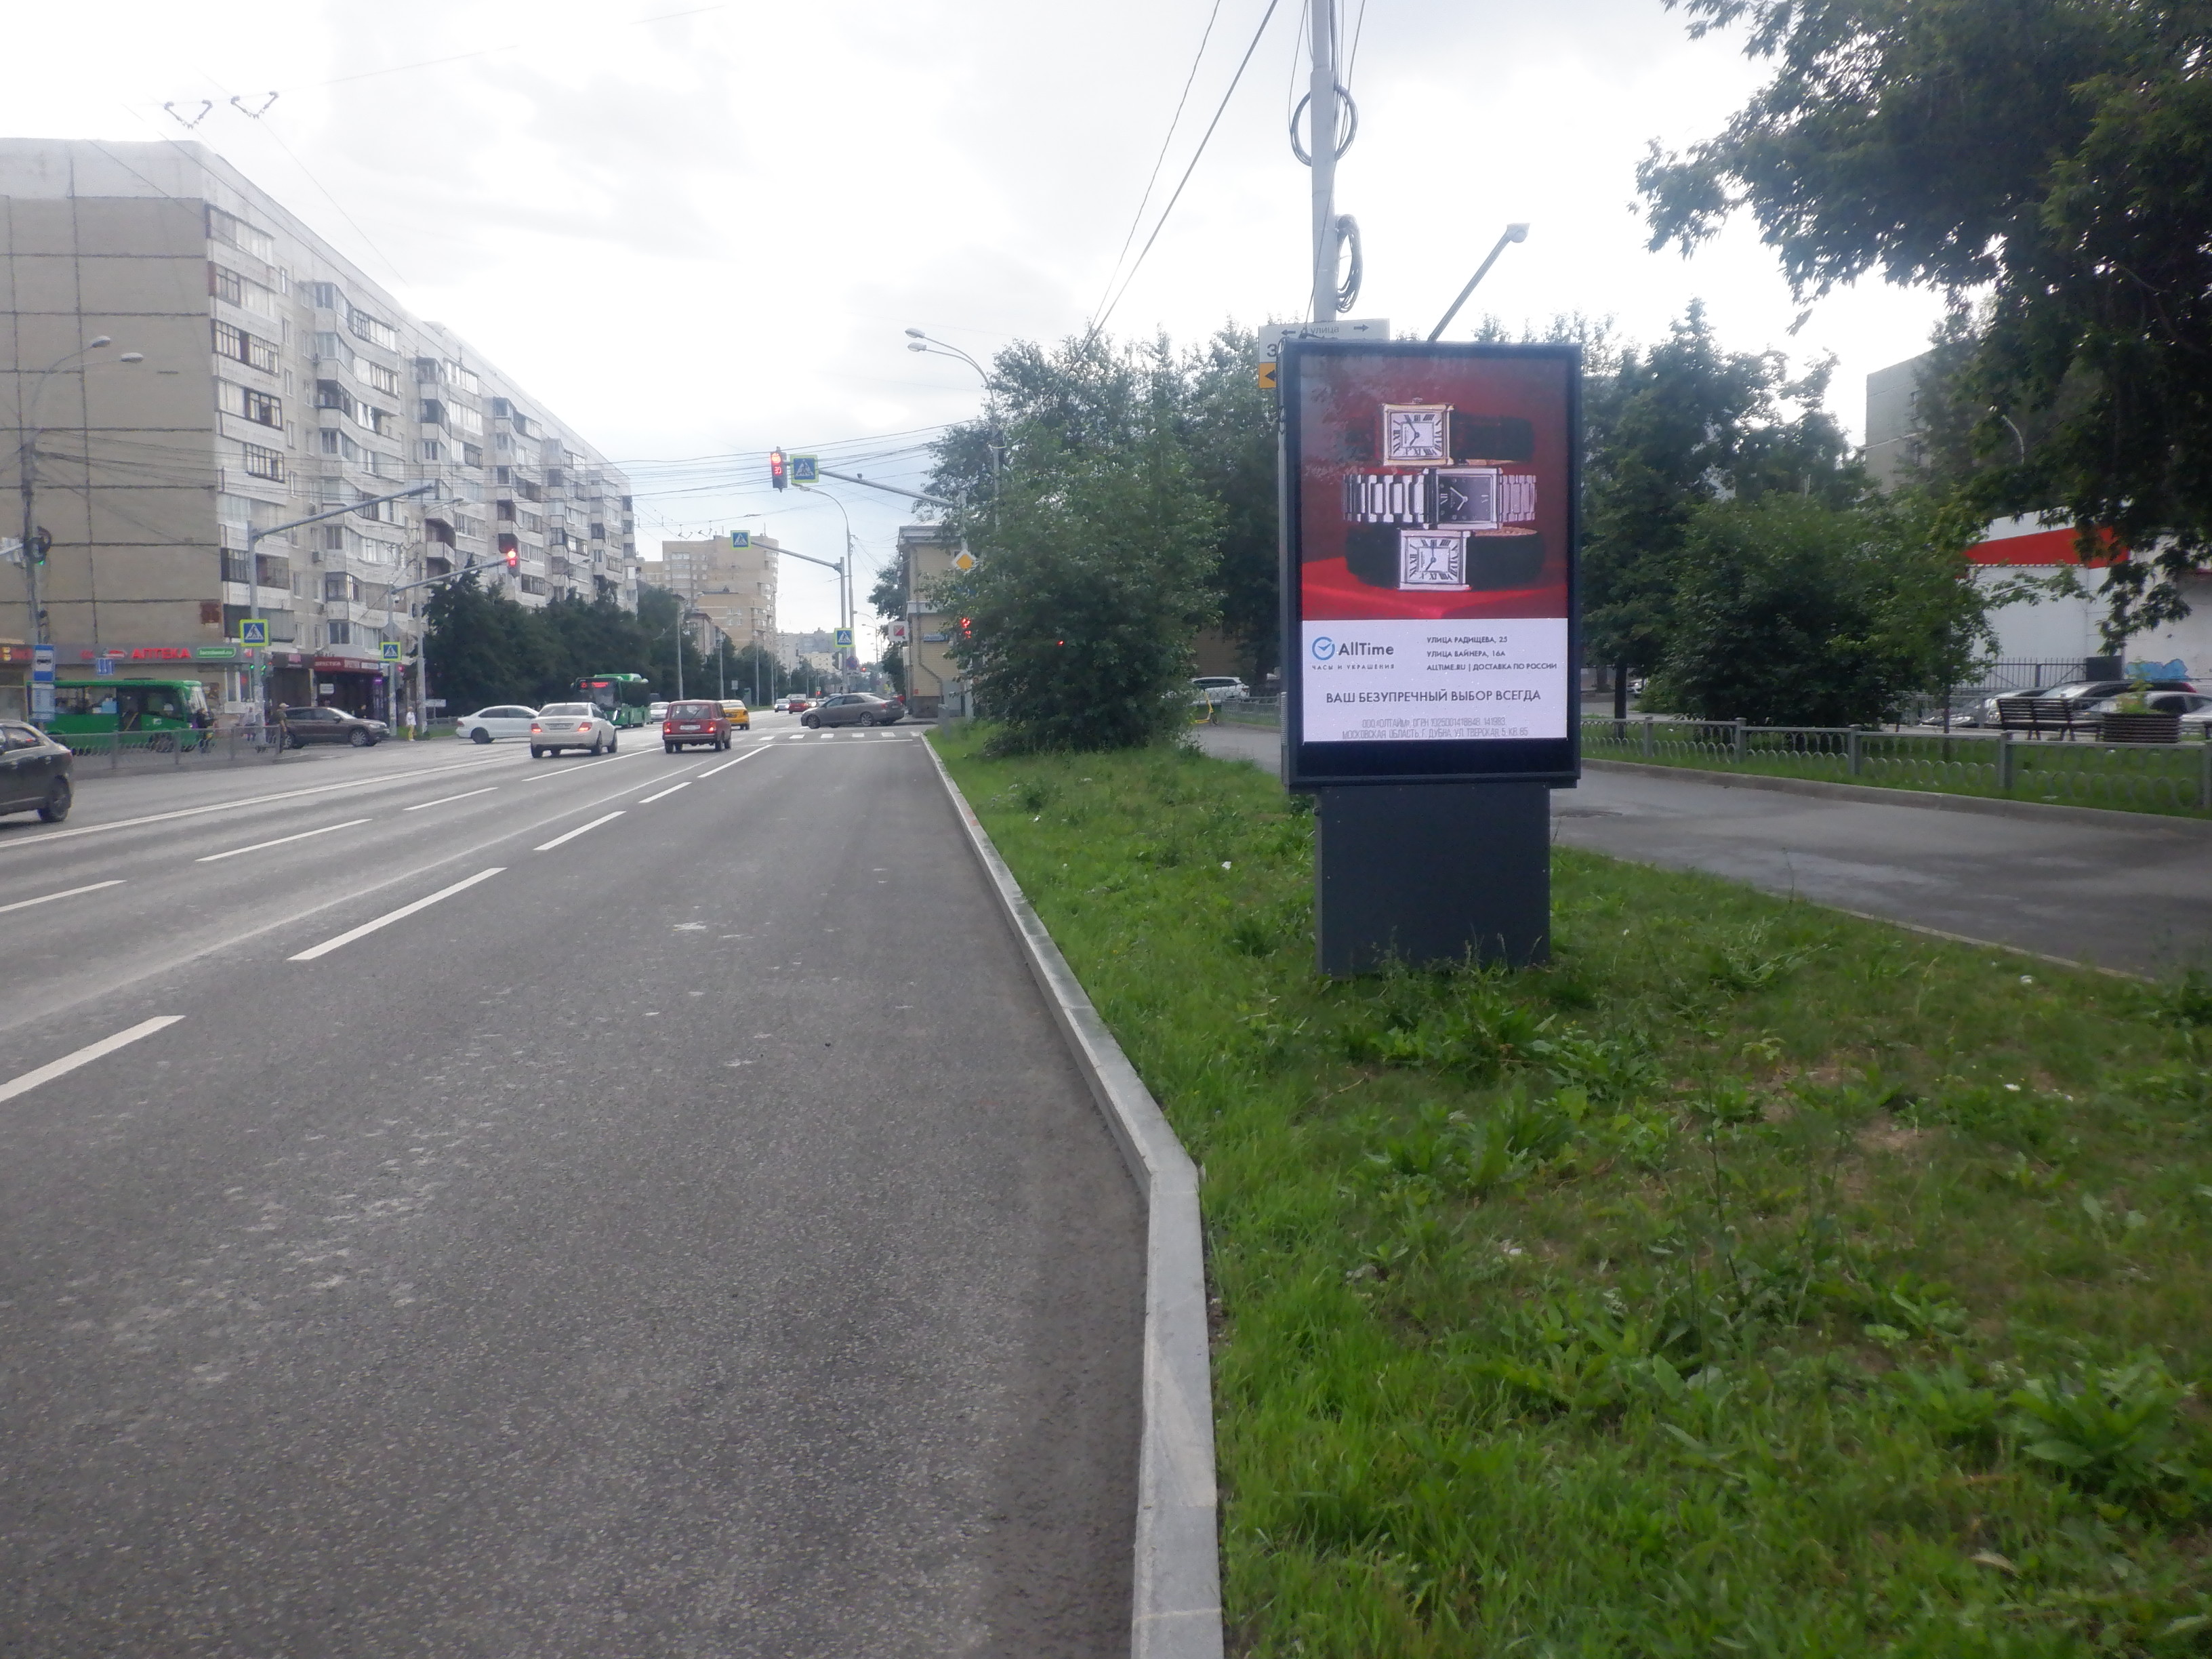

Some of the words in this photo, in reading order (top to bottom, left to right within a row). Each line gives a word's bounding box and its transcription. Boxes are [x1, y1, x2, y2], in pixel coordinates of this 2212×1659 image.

[1311, 326, 1339, 335] улица
[131, 647, 192, 659] АПТЕКА
[1338, 641, 1394, 656] AllTime
[1454, 649, 1489, 658] ВАЙНЕРА,
[1473, 663, 1512, 672] ДОСТАВКА
[1326, 693, 1355, 703] ВАШ
[1359, 689, 1448, 703] БЕЗУПРЕЧНЫЙ
[1451, 691, 1492, 701] ВЫБОР
[1496, 690, 1541, 701] ВСЕГДА
[1362, 719, 1376, 728] ООО
